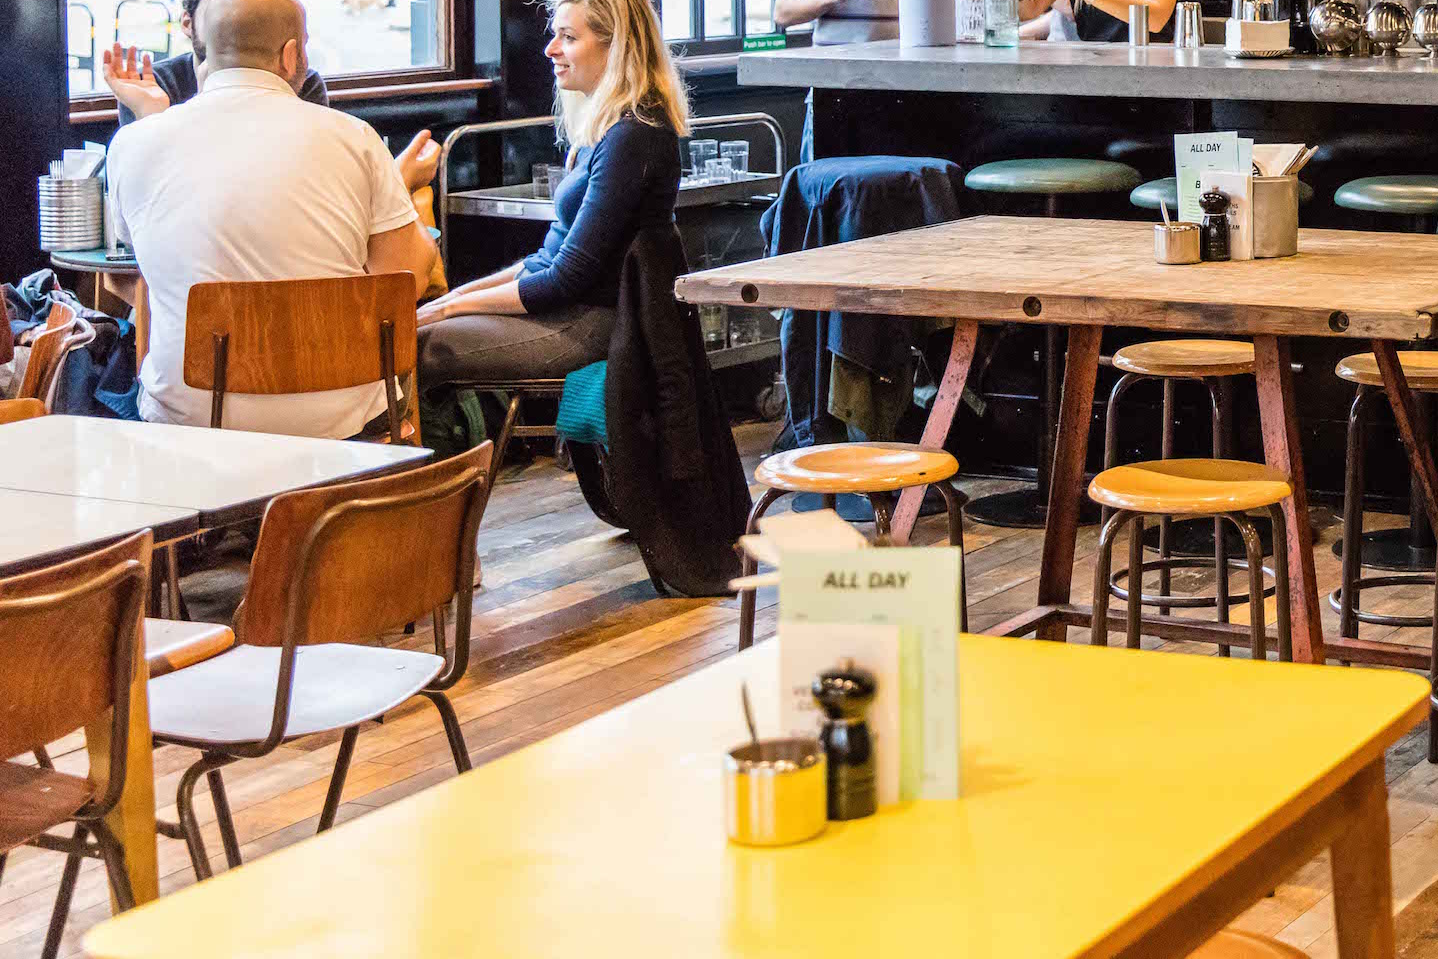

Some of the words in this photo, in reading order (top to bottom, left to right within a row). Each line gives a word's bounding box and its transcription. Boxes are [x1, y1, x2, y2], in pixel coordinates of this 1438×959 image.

[1190, 144, 1204, 153] ALL
[1206, 143, 1222, 152] DAY
[822, 571, 860, 589] ALL
[868, 571, 910, 589] DAY
